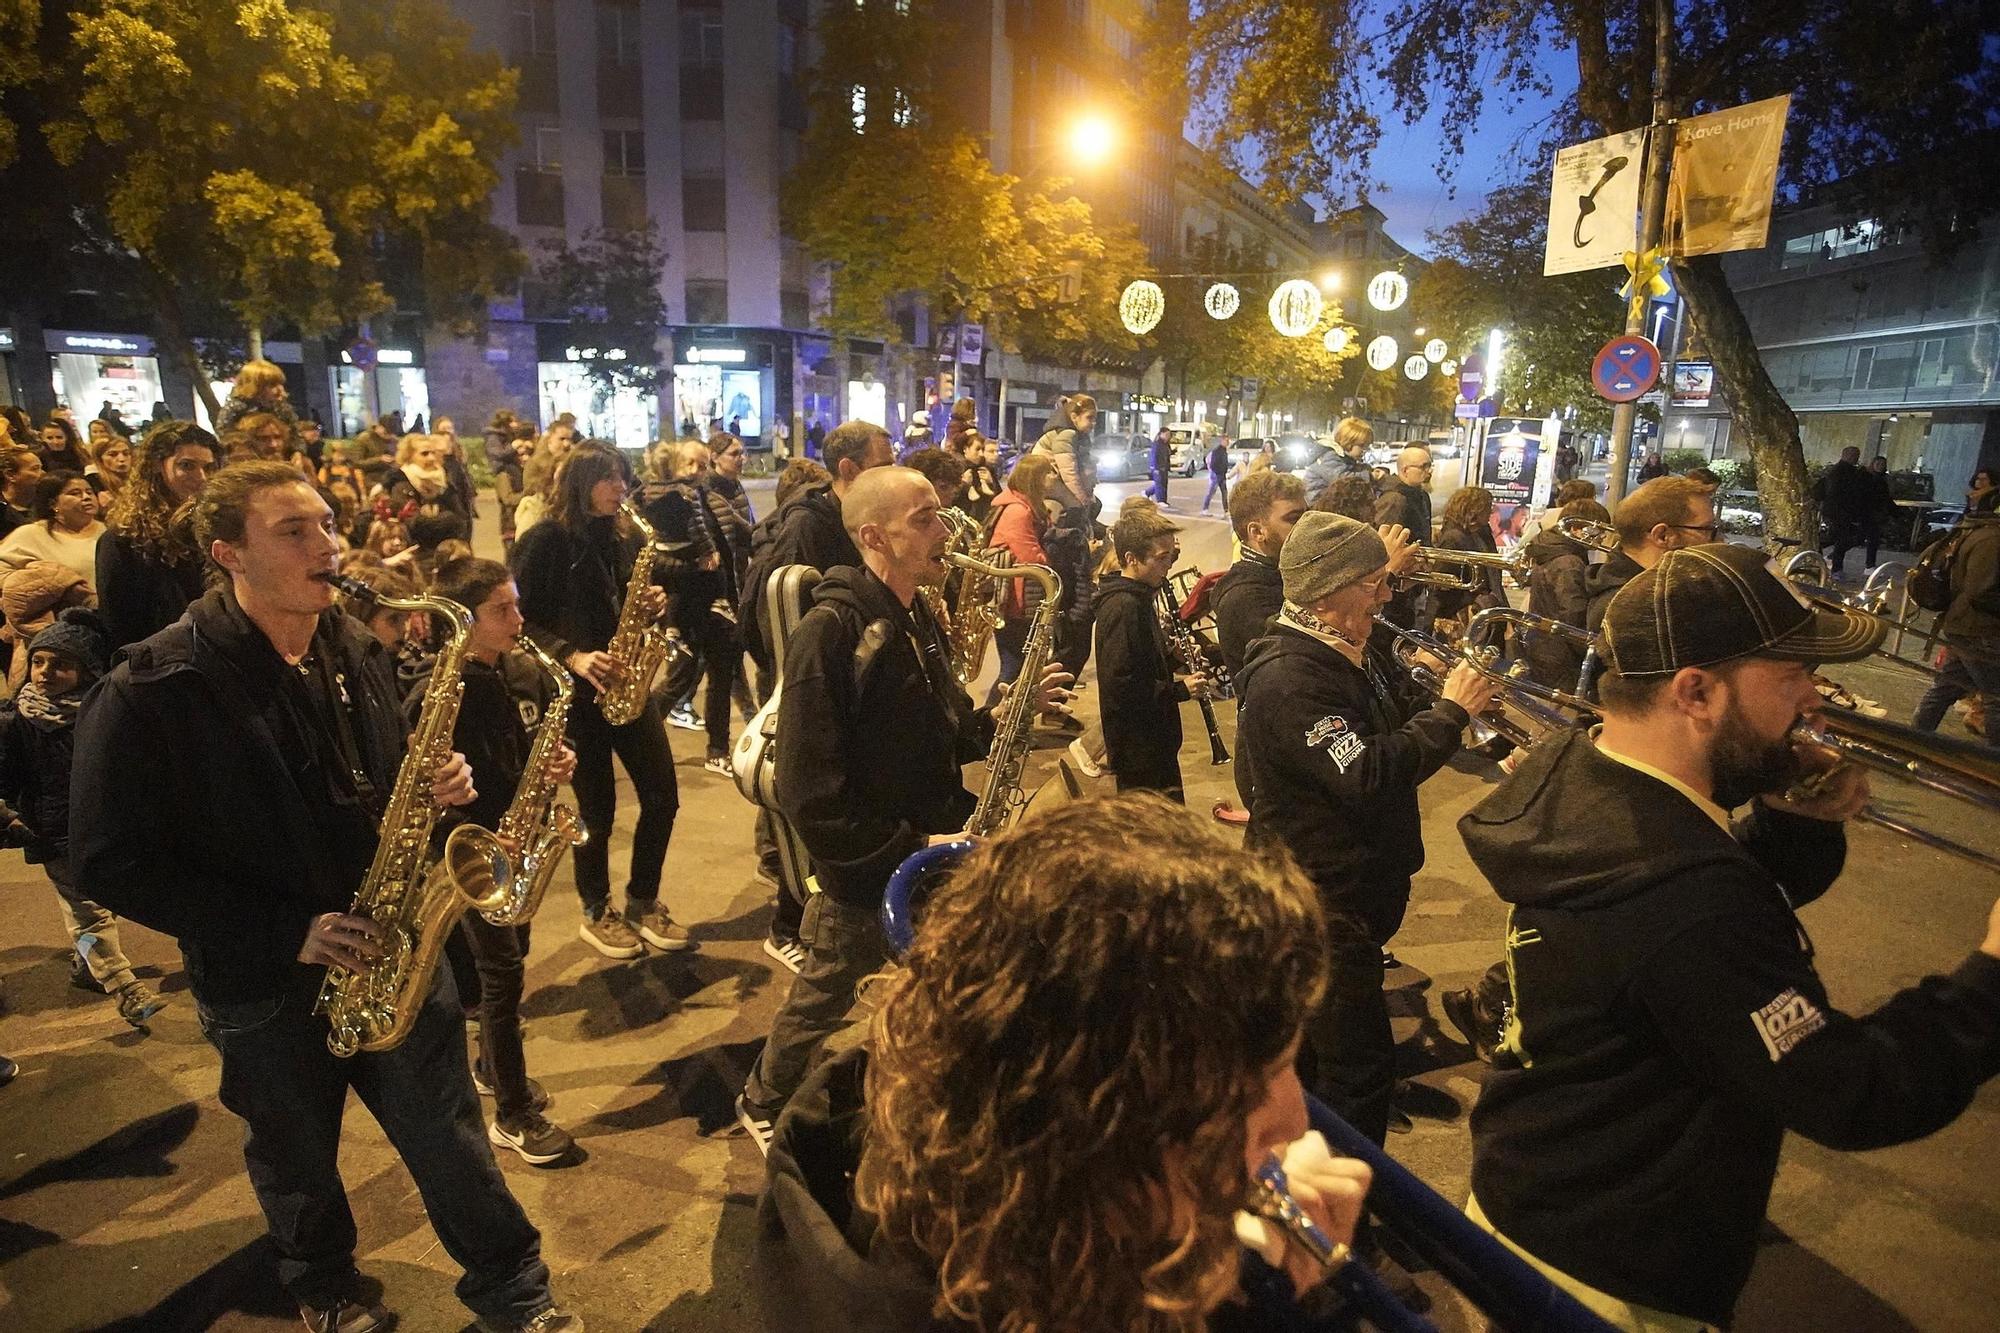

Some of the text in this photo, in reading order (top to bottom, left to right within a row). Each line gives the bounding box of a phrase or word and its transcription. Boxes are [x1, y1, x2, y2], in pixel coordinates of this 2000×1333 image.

[1728, 112, 1776, 133] Home
[1330, 732, 1354, 750] FESTIVAL
[1342, 745, 1366, 766] GIRONA
